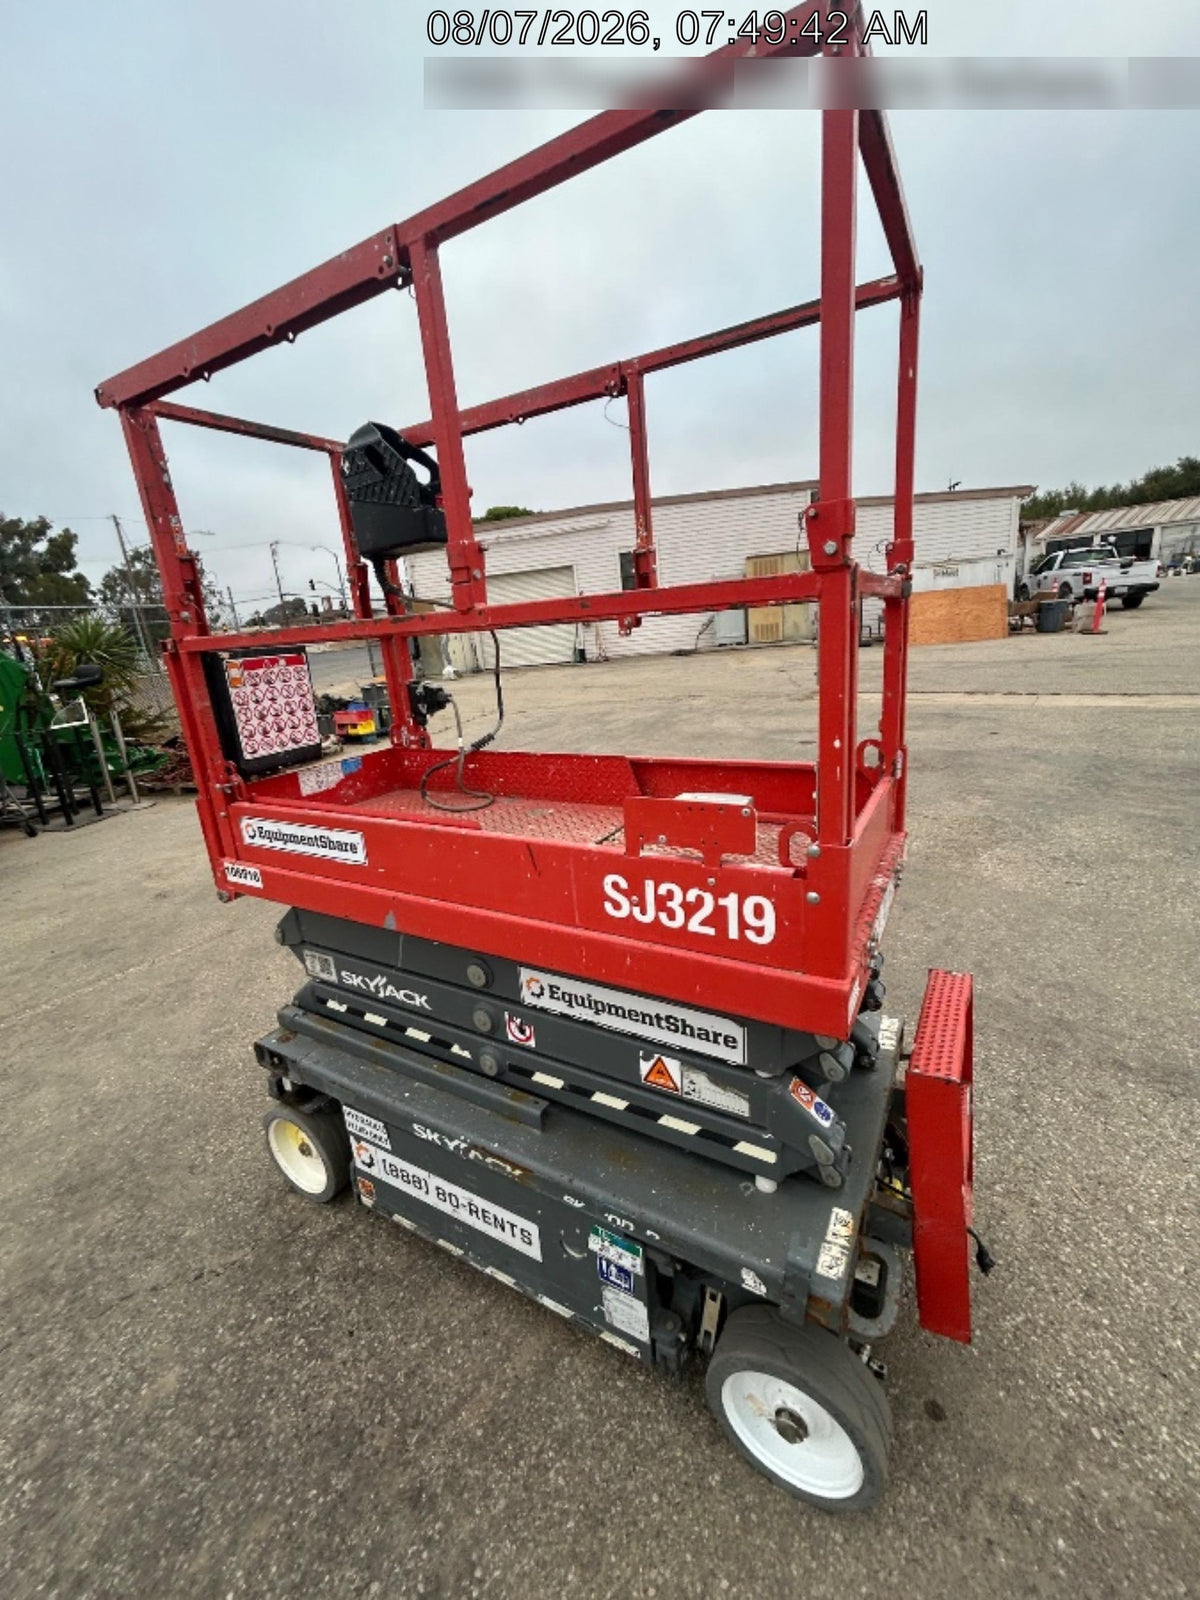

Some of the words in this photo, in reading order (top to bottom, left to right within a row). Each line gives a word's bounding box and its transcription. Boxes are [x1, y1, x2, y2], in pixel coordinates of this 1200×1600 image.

[256, 826, 359, 854] EquipmentShare
[602, 874, 776, 945] SJ3219
[340, 970, 432, 1010] SKYJACK
[547, 983, 738, 1050] EquipmentShare
[382, 1158, 430, 1195] (888)
